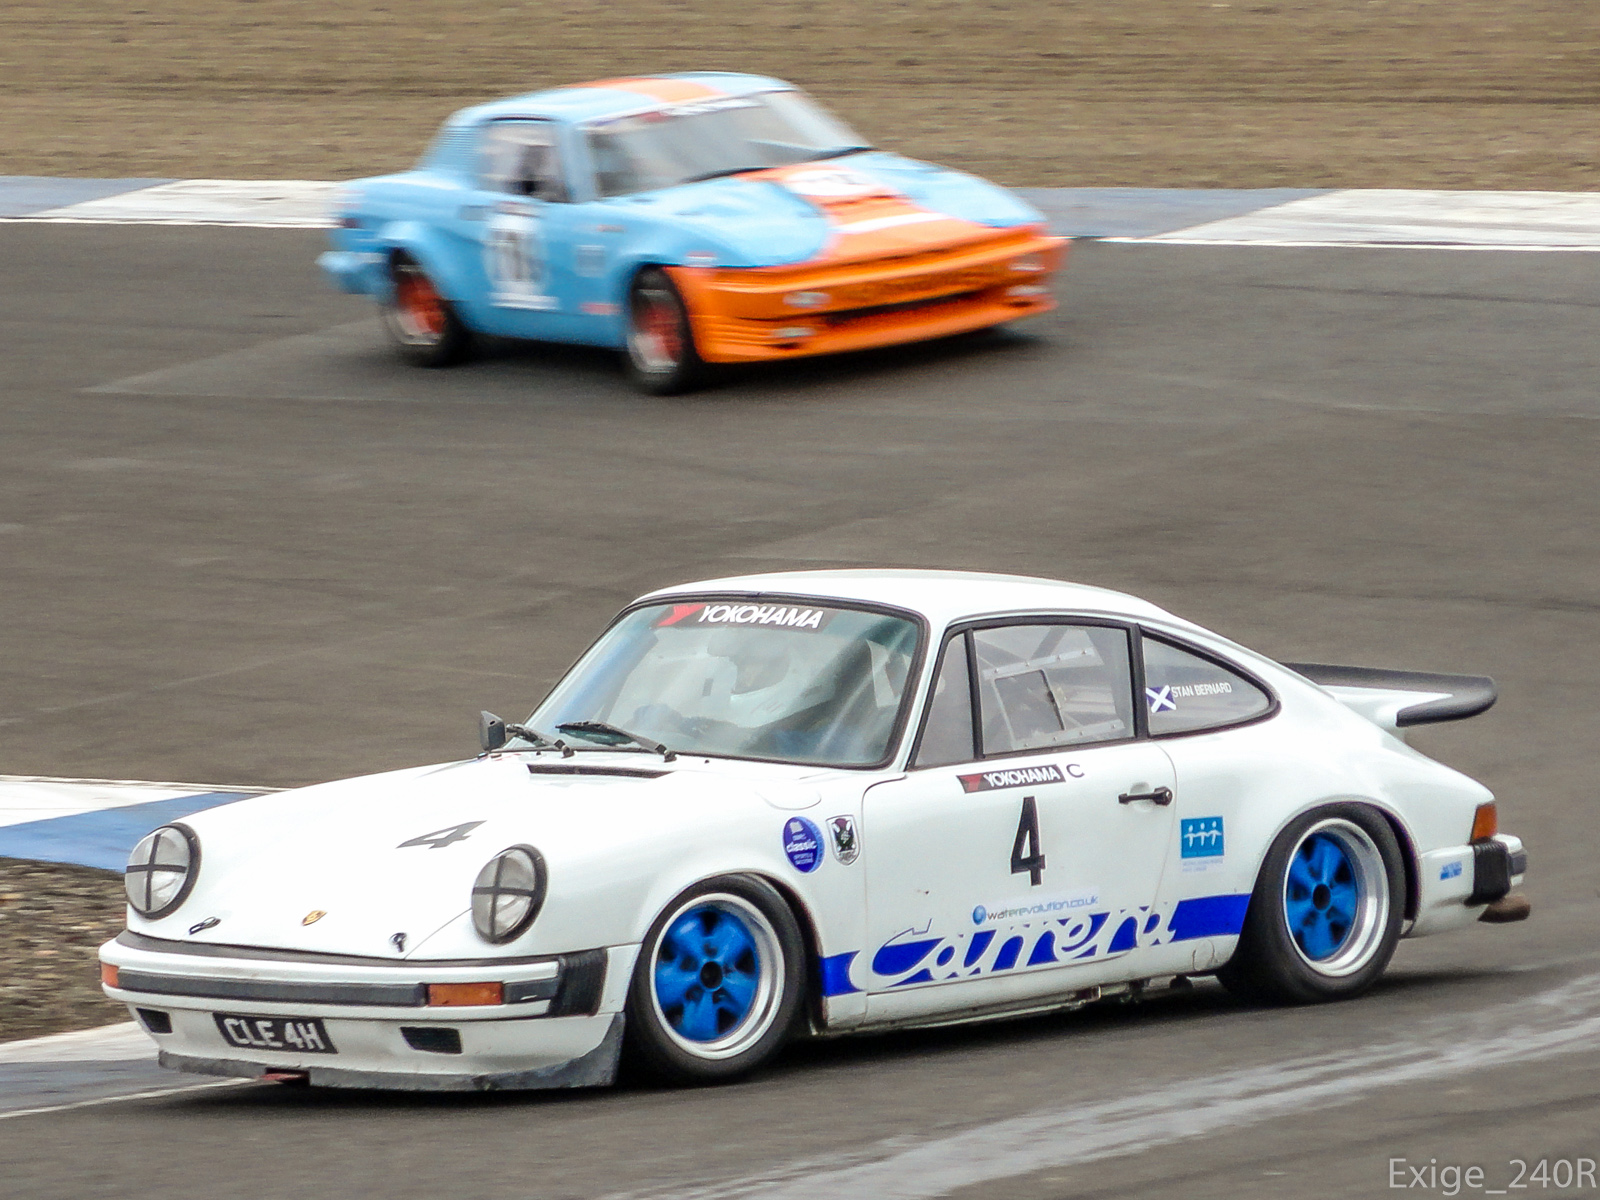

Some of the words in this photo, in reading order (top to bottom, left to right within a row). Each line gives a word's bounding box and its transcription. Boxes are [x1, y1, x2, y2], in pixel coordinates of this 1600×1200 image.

[698, 605, 824, 629] YOKOHAMA
[1171, 685, 1195, 698] STAN
[1194, 682, 1232, 696] BERNARD
[983, 766, 1061, 788] YOKOHAMA
[1066, 763, 1085, 779] C
[395, 819, 488, 850] 4
[1010, 795, 1046, 887] 4
[987, 896, 1099, 920] waterevolution.co.uk
[849, 905, 1172, 990] Carrera
[224, 1018, 283, 1048] CLE
[284, 1021, 326, 1050] 4H
